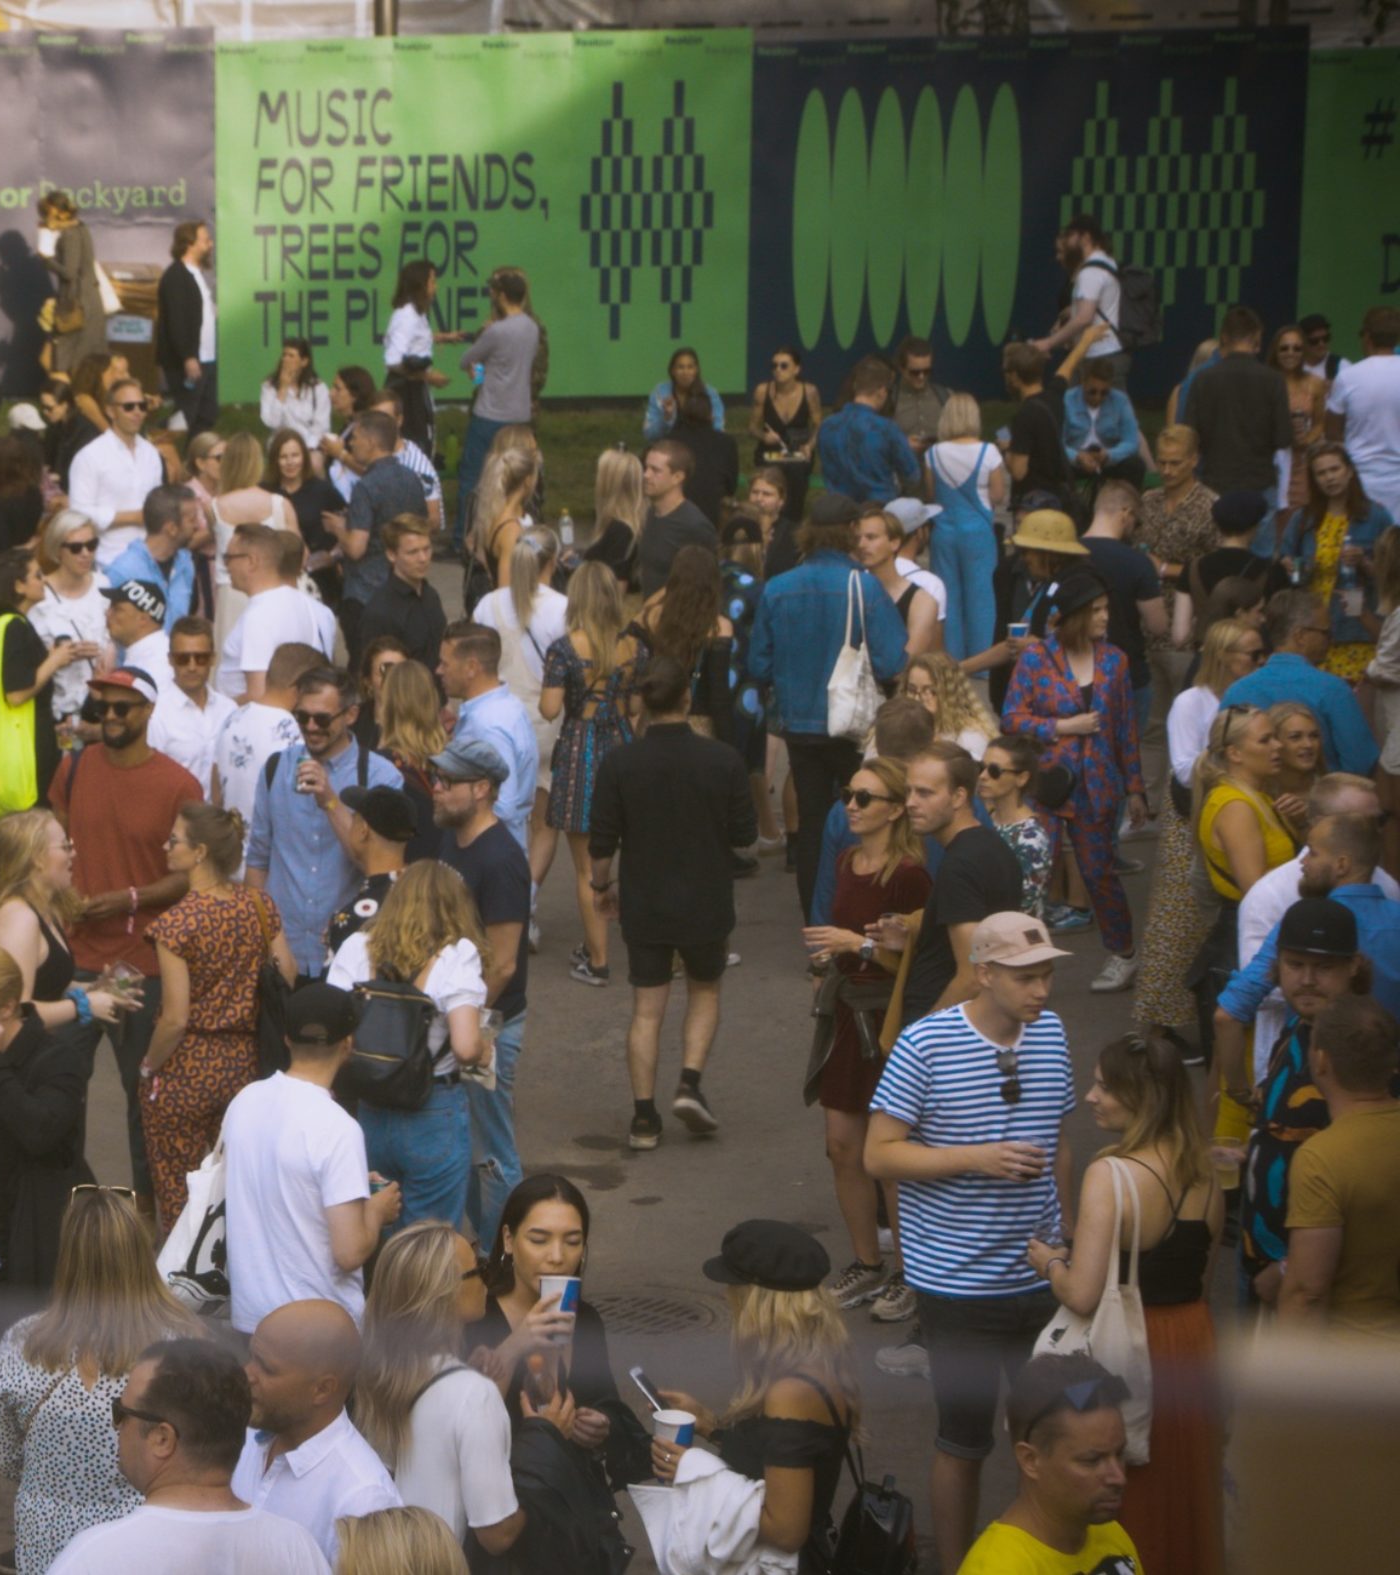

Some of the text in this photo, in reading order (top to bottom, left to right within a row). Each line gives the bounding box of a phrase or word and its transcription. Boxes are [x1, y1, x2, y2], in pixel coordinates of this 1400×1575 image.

[253, 88, 393, 148] MUSIC
[253, 151, 549, 222] FOR FRIENDS,
[254, 219, 479, 282] TREES FOR
[254, 286, 492, 348] THE PLNE
